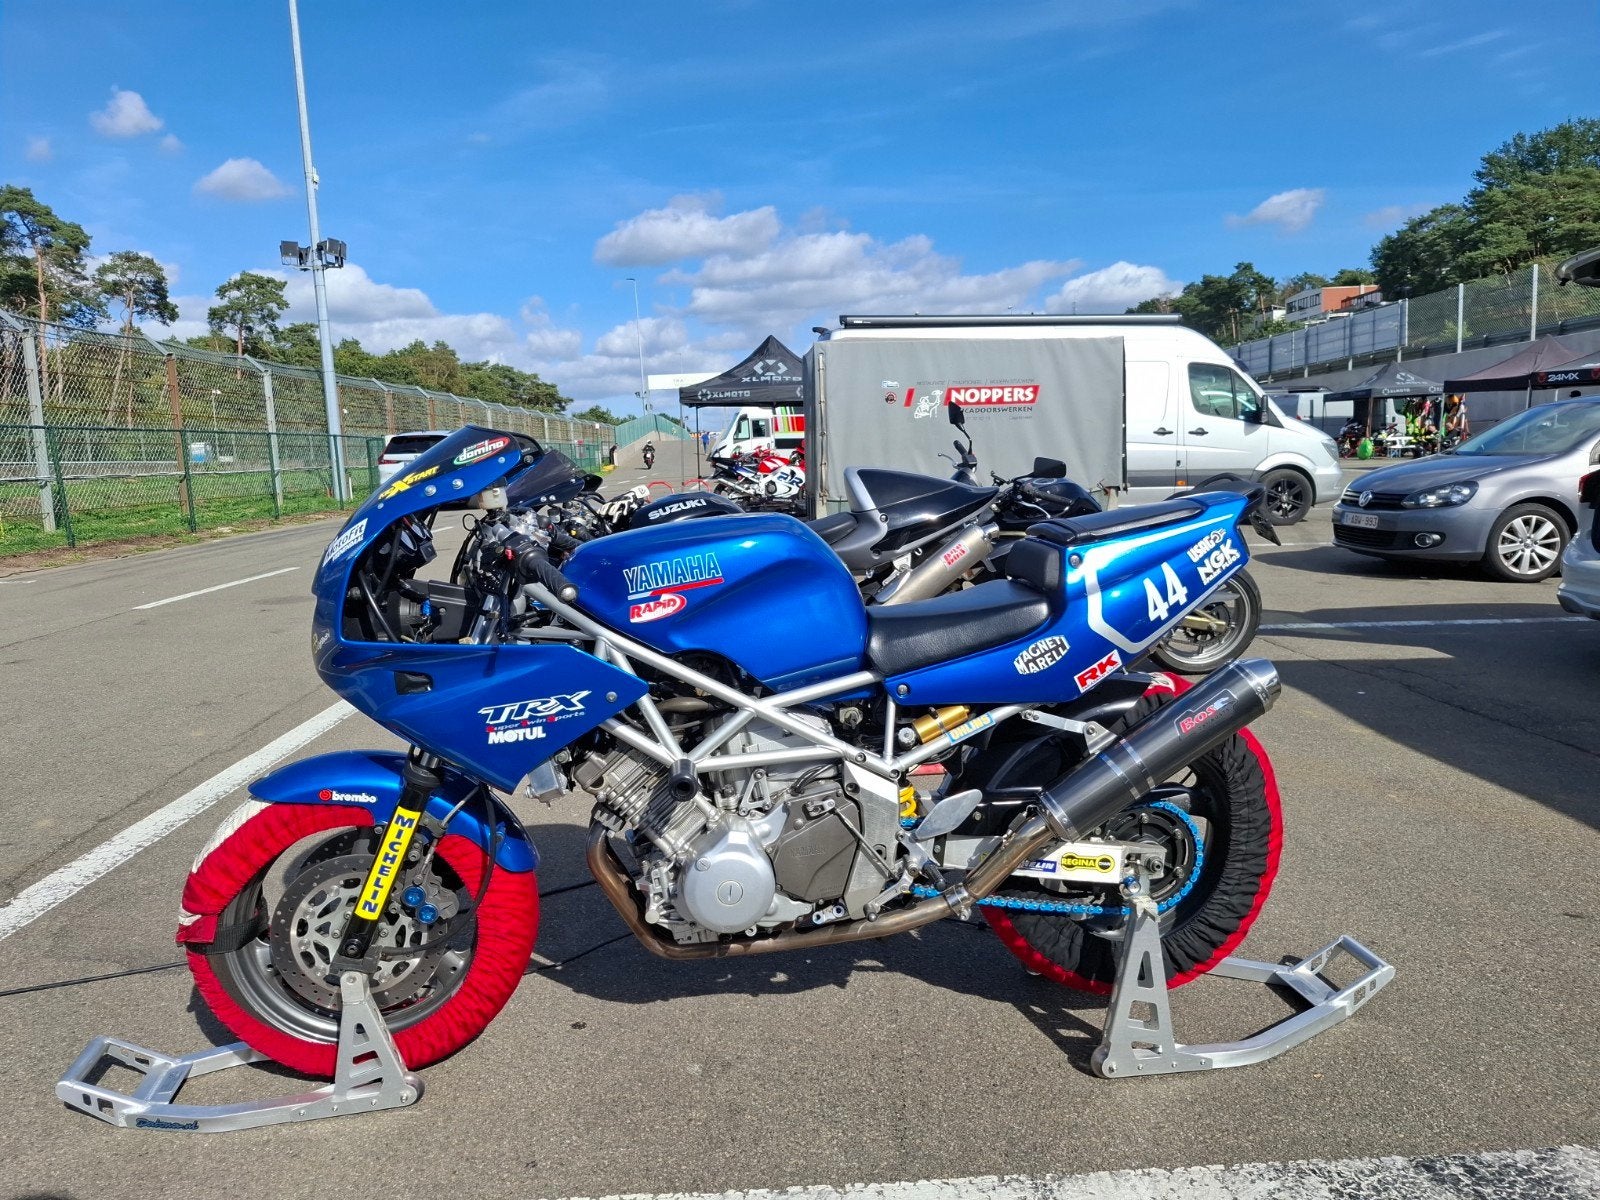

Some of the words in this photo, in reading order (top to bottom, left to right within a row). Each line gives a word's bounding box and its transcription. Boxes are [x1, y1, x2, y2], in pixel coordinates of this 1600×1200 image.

[1547, 372, 1579, 381] 24MX
[712, 390, 751, 398] XLMOTO
[951, 387, 1035, 403] NOPPERS
[459, 439, 504, 461] domino
[648, 499, 707, 520] SUZUKI
[1197, 539, 1239, 582] NGK
[623, 552, 722, 593] YAMAHA
[1143, 562, 1188, 621] 44
[1077, 652, 1119, 688] RK
[478, 690, 592, 724] TRX
[488, 726, 546, 744] MOTUL
[331, 790, 377, 803] brembo
[361, 814, 416, 913] MICHELIN
[1061, 857, 1096, 867] REGINA
